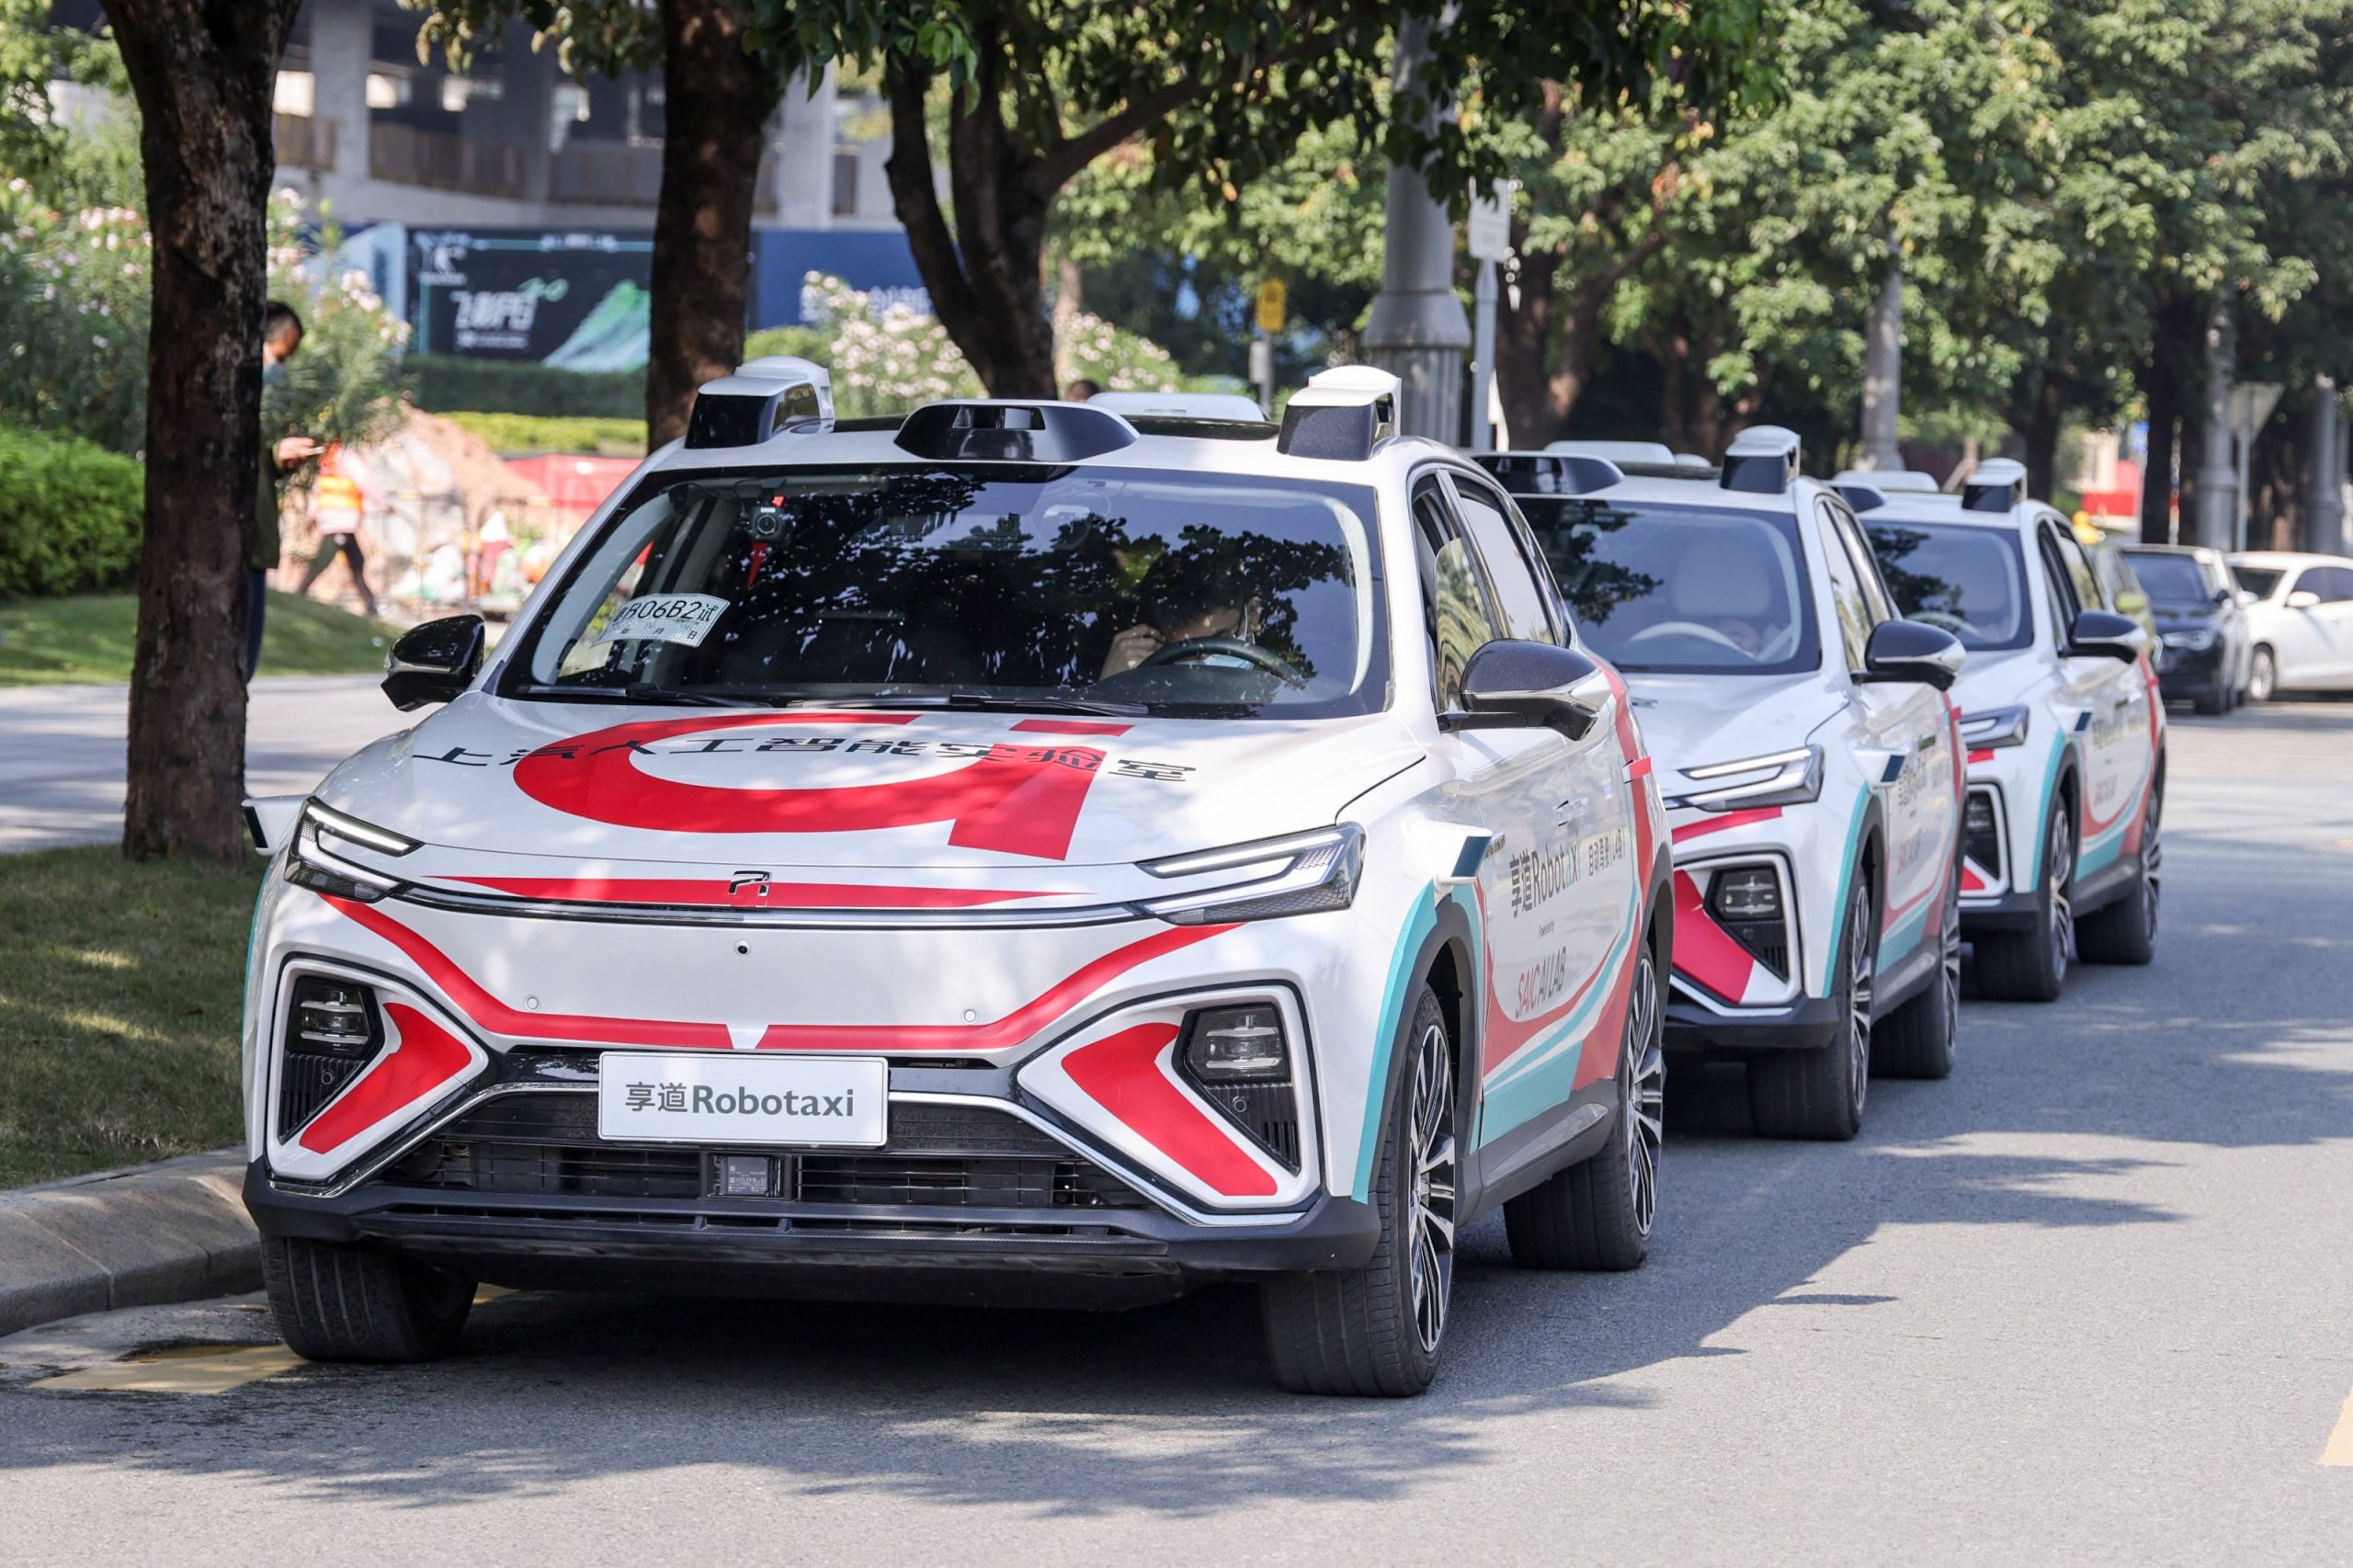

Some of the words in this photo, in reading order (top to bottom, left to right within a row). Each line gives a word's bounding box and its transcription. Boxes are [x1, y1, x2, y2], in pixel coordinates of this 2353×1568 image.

[412, 737, 1196, 782] 上汽人工智能实验室
[624, 1081, 854, 1117] 享道Robotaxi
